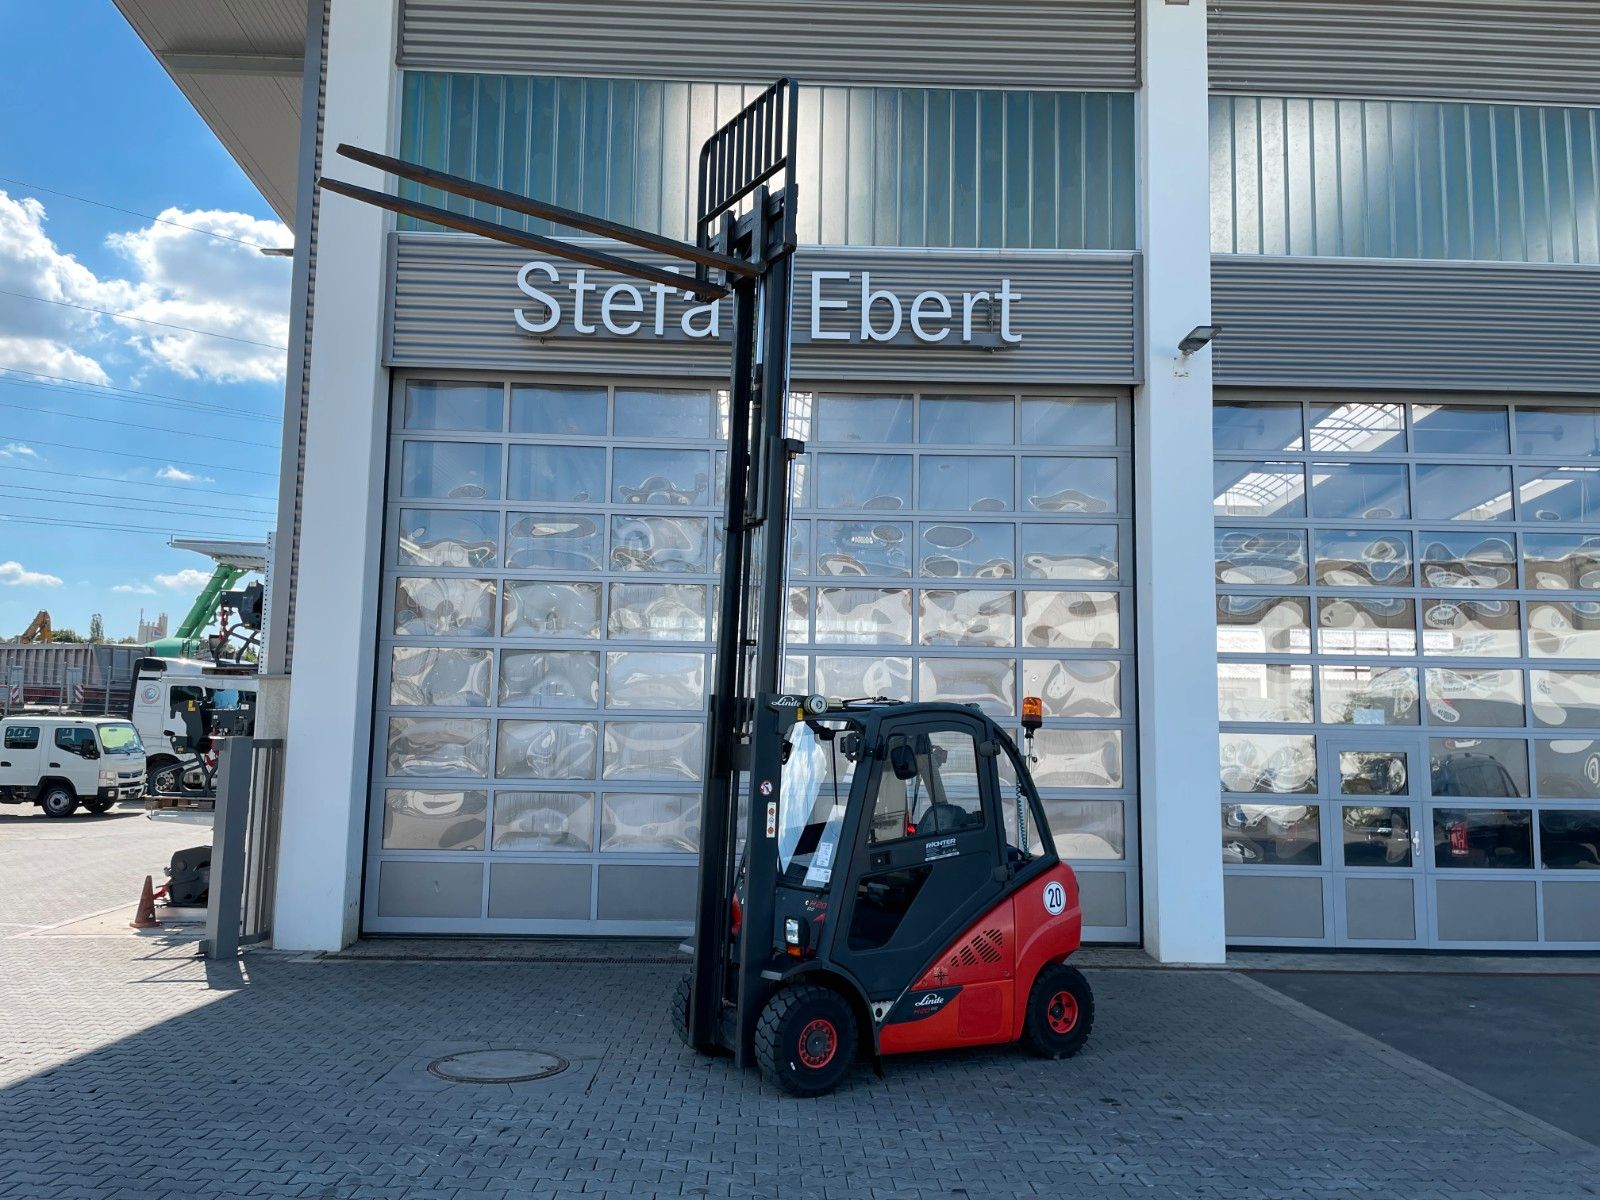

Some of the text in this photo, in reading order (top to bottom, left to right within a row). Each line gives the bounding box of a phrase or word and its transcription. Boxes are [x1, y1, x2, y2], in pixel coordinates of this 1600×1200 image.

[514, 261, 1023, 343] Stefa Ebert
[771, 695, 801, 707] Linde
[925, 838, 956, 848] RICHTER
[1048, 887, 1062, 908] 20
[914, 993, 945, 1006] Linde
